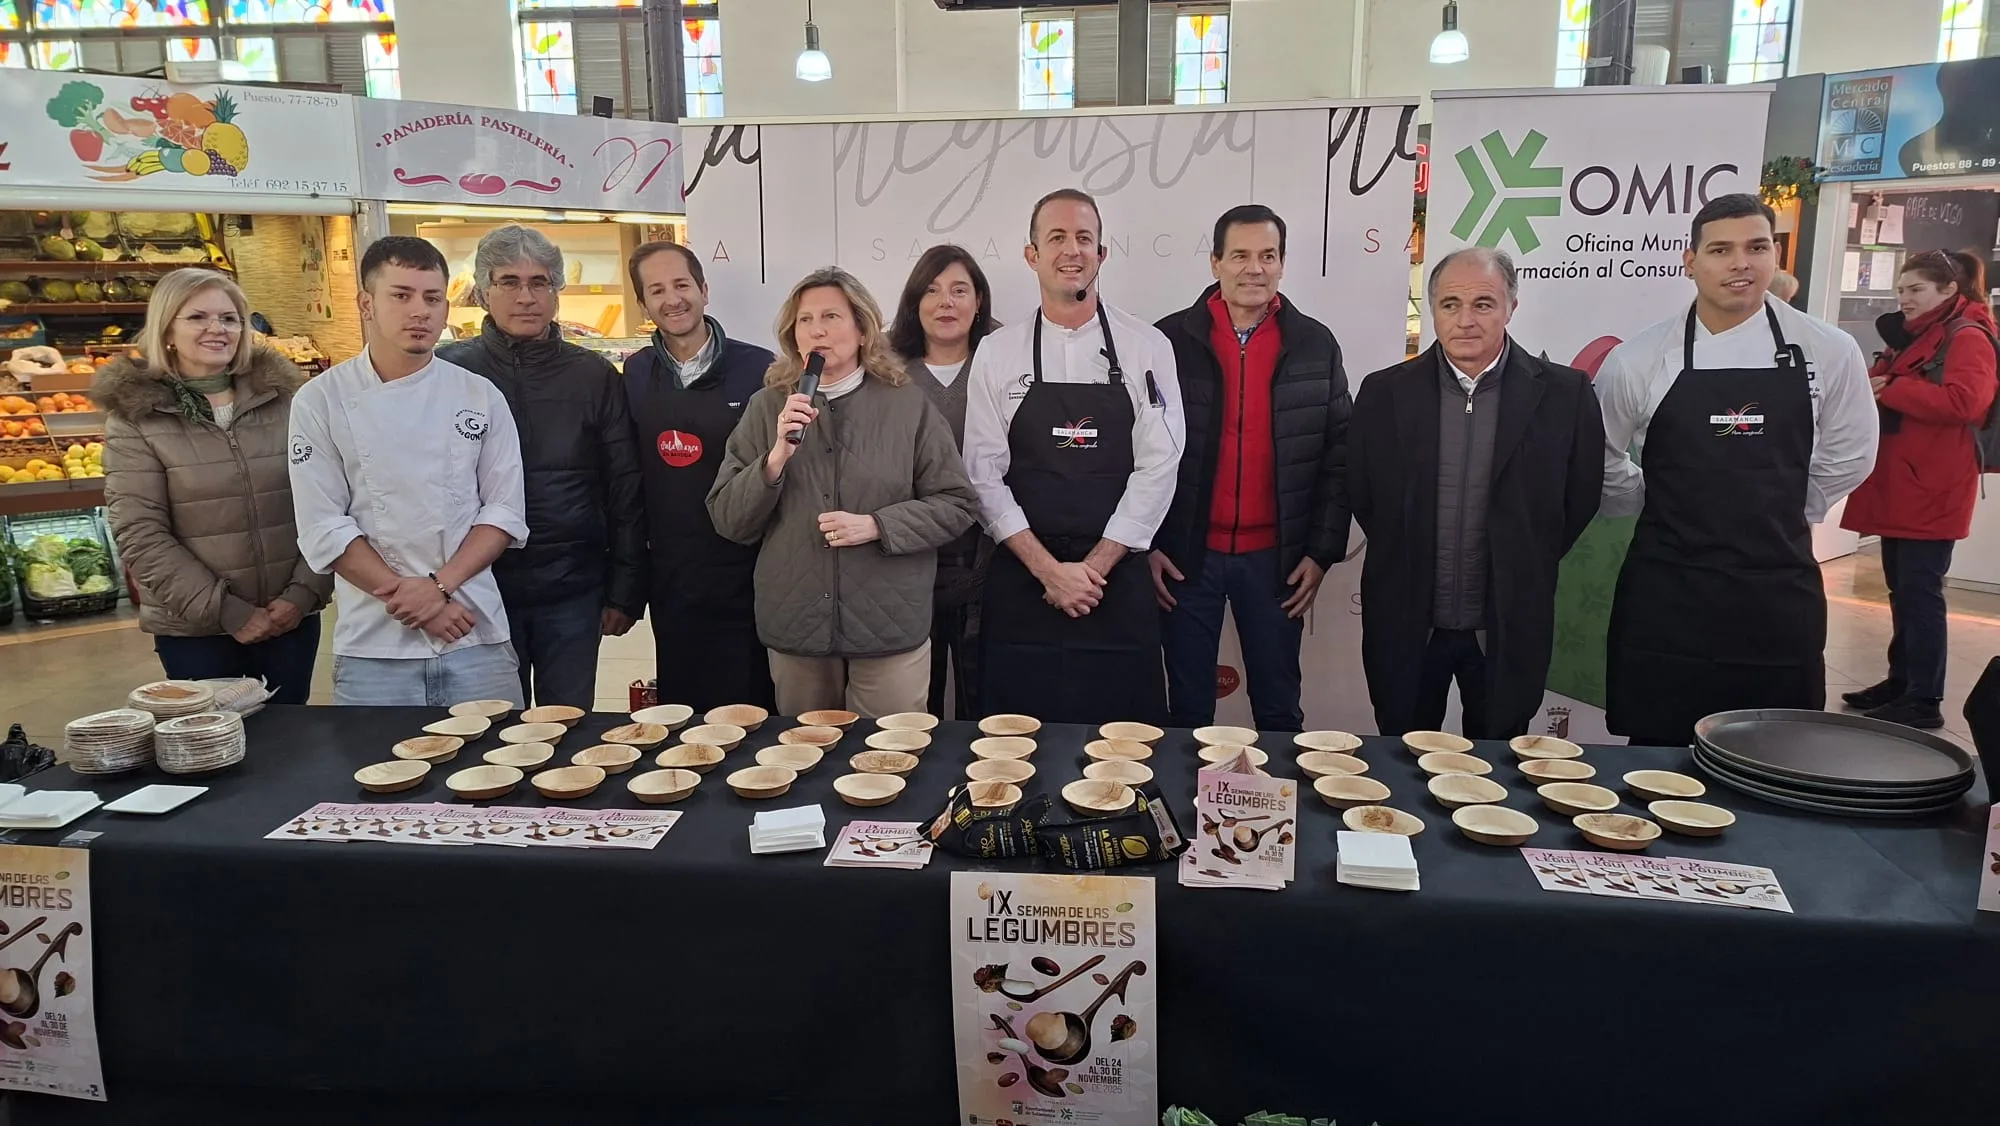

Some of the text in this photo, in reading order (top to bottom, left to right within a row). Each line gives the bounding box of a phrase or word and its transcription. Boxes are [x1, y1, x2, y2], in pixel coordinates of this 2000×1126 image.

[1831, 80, 1889, 96] Mercado
[287, 94, 338, 107] 77-78-79
[1831, 93, 1888, 109] Central
[381, 111, 567, 166] PANADERÍA PASTELERÍA
[1831, 136, 1876, 157] M C
[1912, 161, 1956, 172] Puestos
[265, 179, 289, 190] 692
[295, 180, 310, 191] 15
[312, 181, 328, 191] 37
[333, 182, 348, 192] 15
[1569, 162, 1739, 217] OMIC
[1565, 233, 1693, 253] Oficina Muni
[1515, 260, 1590, 280] rmación
[1596, 258, 1613, 279] al
[1217, 781, 1230, 793] IX
[1207, 791, 1287, 811] LEGUMBRES
[14, 873, 27, 884] DE
[29, 874, 50, 885] LAS
[988, 890, 1013, 917] IX
[1017, 905, 1110, 920] SEMANA DE LAS
[967, 917, 1136, 948] LEGUMBRES
[1095, 1057, 1122, 1067] DEL 24
[1088, 1065, 1122, 1076] AL 30 DE
[1078, 1073, 1123, 1086] NOVIEMBRE
